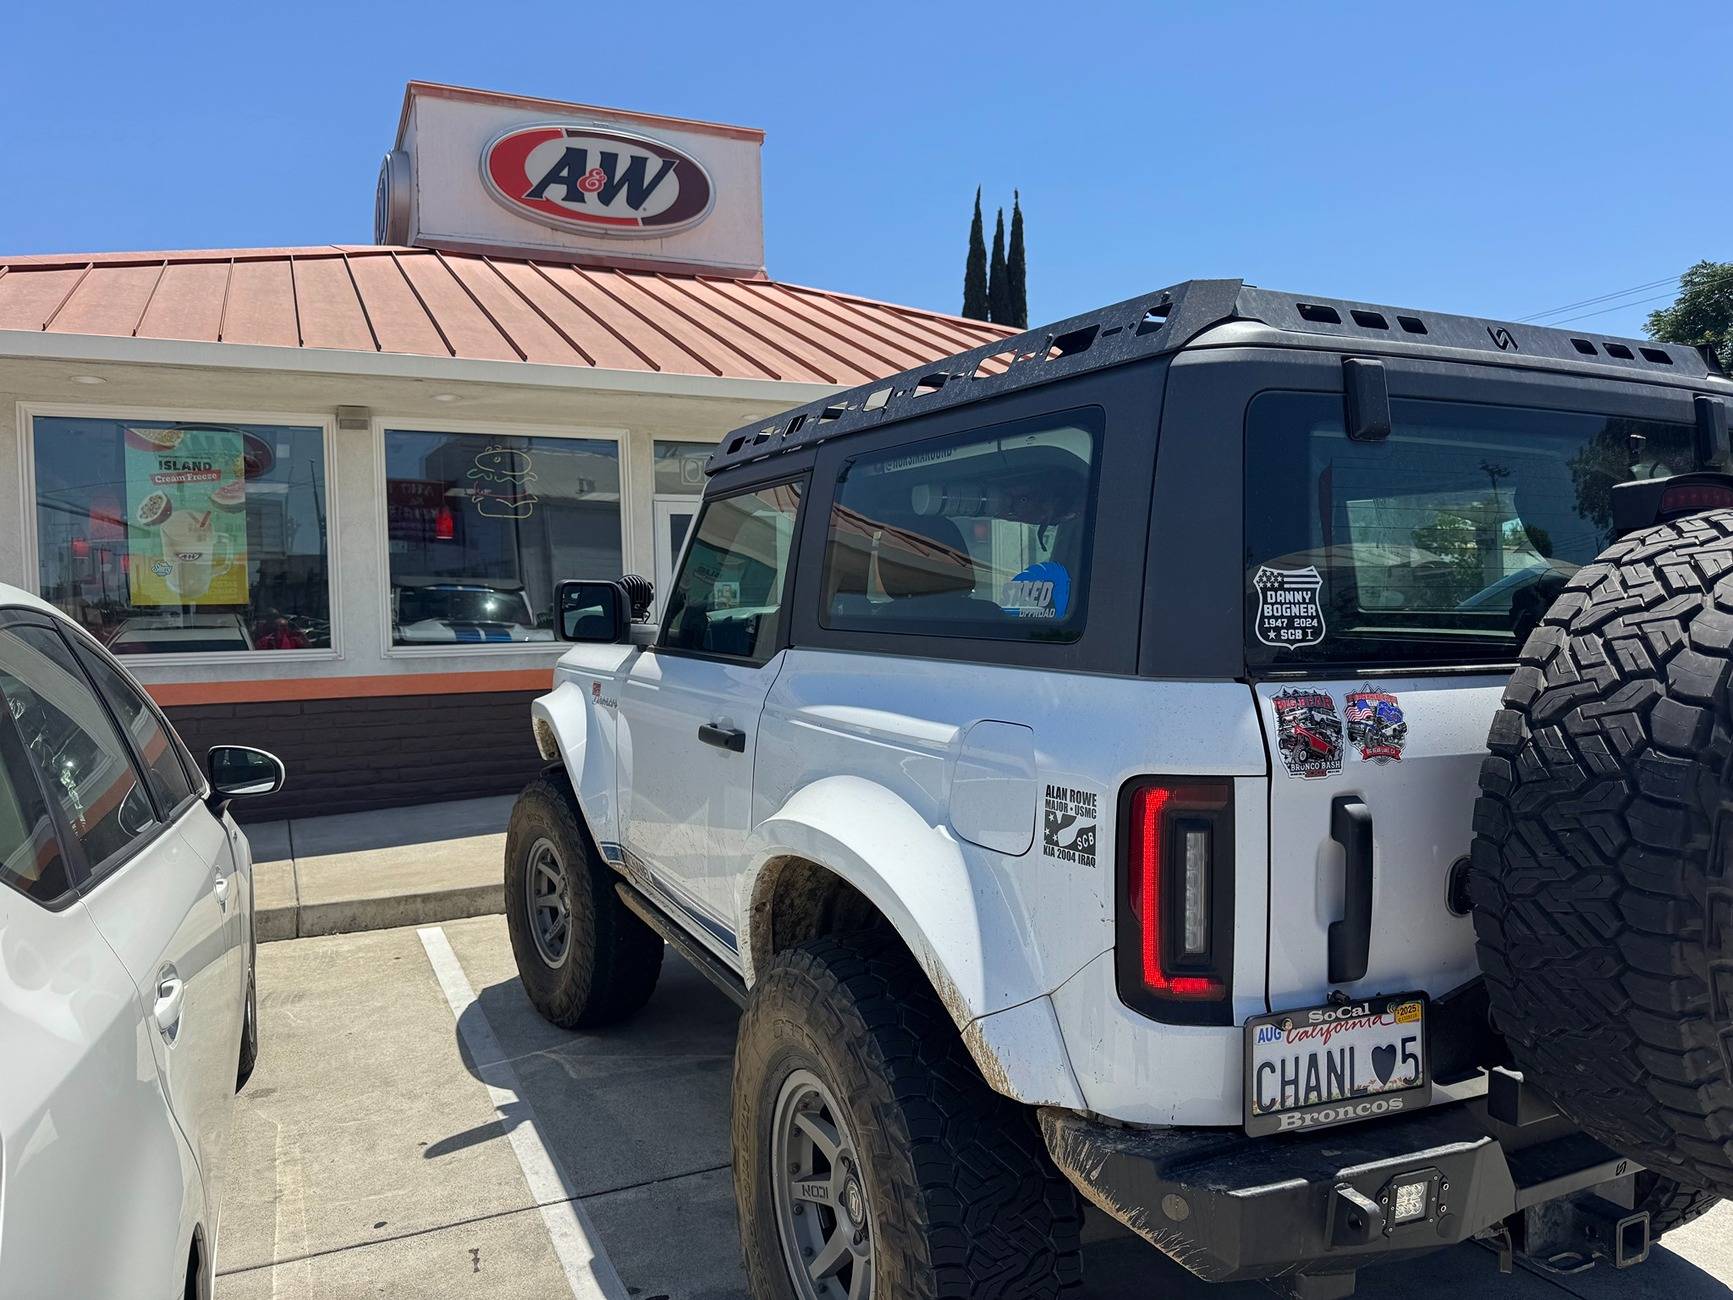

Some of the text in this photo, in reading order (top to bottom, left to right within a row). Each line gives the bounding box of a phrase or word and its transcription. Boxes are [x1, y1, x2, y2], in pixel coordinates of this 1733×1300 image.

[520, 146, 679, 212] A&W
[159, 460, 212, 471] ISLAND
[155, 473, 217, 483] Cream Freeze
[1267, 591, 1311, 603] DANNY
[1263, 604, 1316, 616] BOGNER
[1264, 618, 1318, 627] 1947 2024
[1280, 629, 1303, 639] SCB
[1298, 695, 1333, 710] BEAR
[1290, 762, 1320, 771] BRONCO
[1321, 760, 1340, 769] BASH
[1045, 784, 1097, 807] ALAN ROWE
[1045, 798, 1097, 819] MAJOR USMC
[1076, 832, 1094, 849] SCB
[1043, 844, 1096, 868] KIA 2004 IRAQ
[1308, 1003, 1371, 1023] SoCal
[1257, 1028, 1282, 1043] AUG
[1286, 1015, 1396, 1045] California
[1400, 1004, 1417, 1016] 2025
[1256, 1046, 1368, 1112] CHANL
[1277, 1098, 1404, 1130] Broncos
[802, 1184, 829, 1200] ICON
